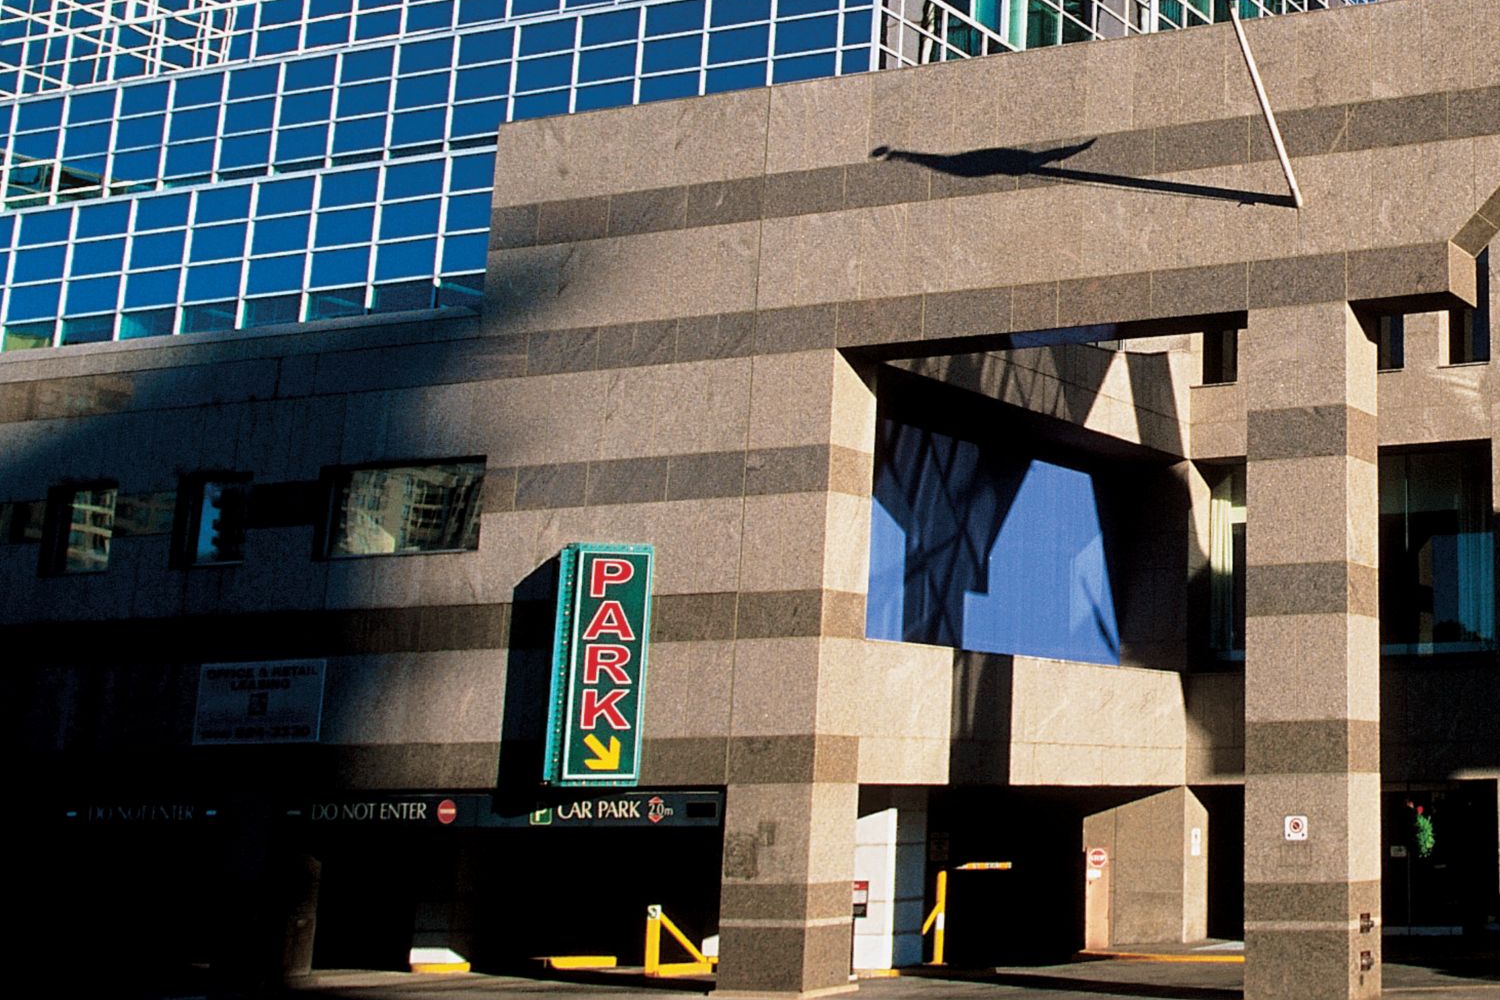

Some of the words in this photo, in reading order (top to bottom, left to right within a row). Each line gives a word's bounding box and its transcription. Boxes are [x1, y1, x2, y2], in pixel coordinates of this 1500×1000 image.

[580, 558, 636, 729] PARK
[311, 803, 338, 821] DO
[342, 802, 376, 821] NOT
[379, 802, 427, 820] ENTER
[557, 800, 592, 819] CAR
[598, 800, 641, 819] PARK
